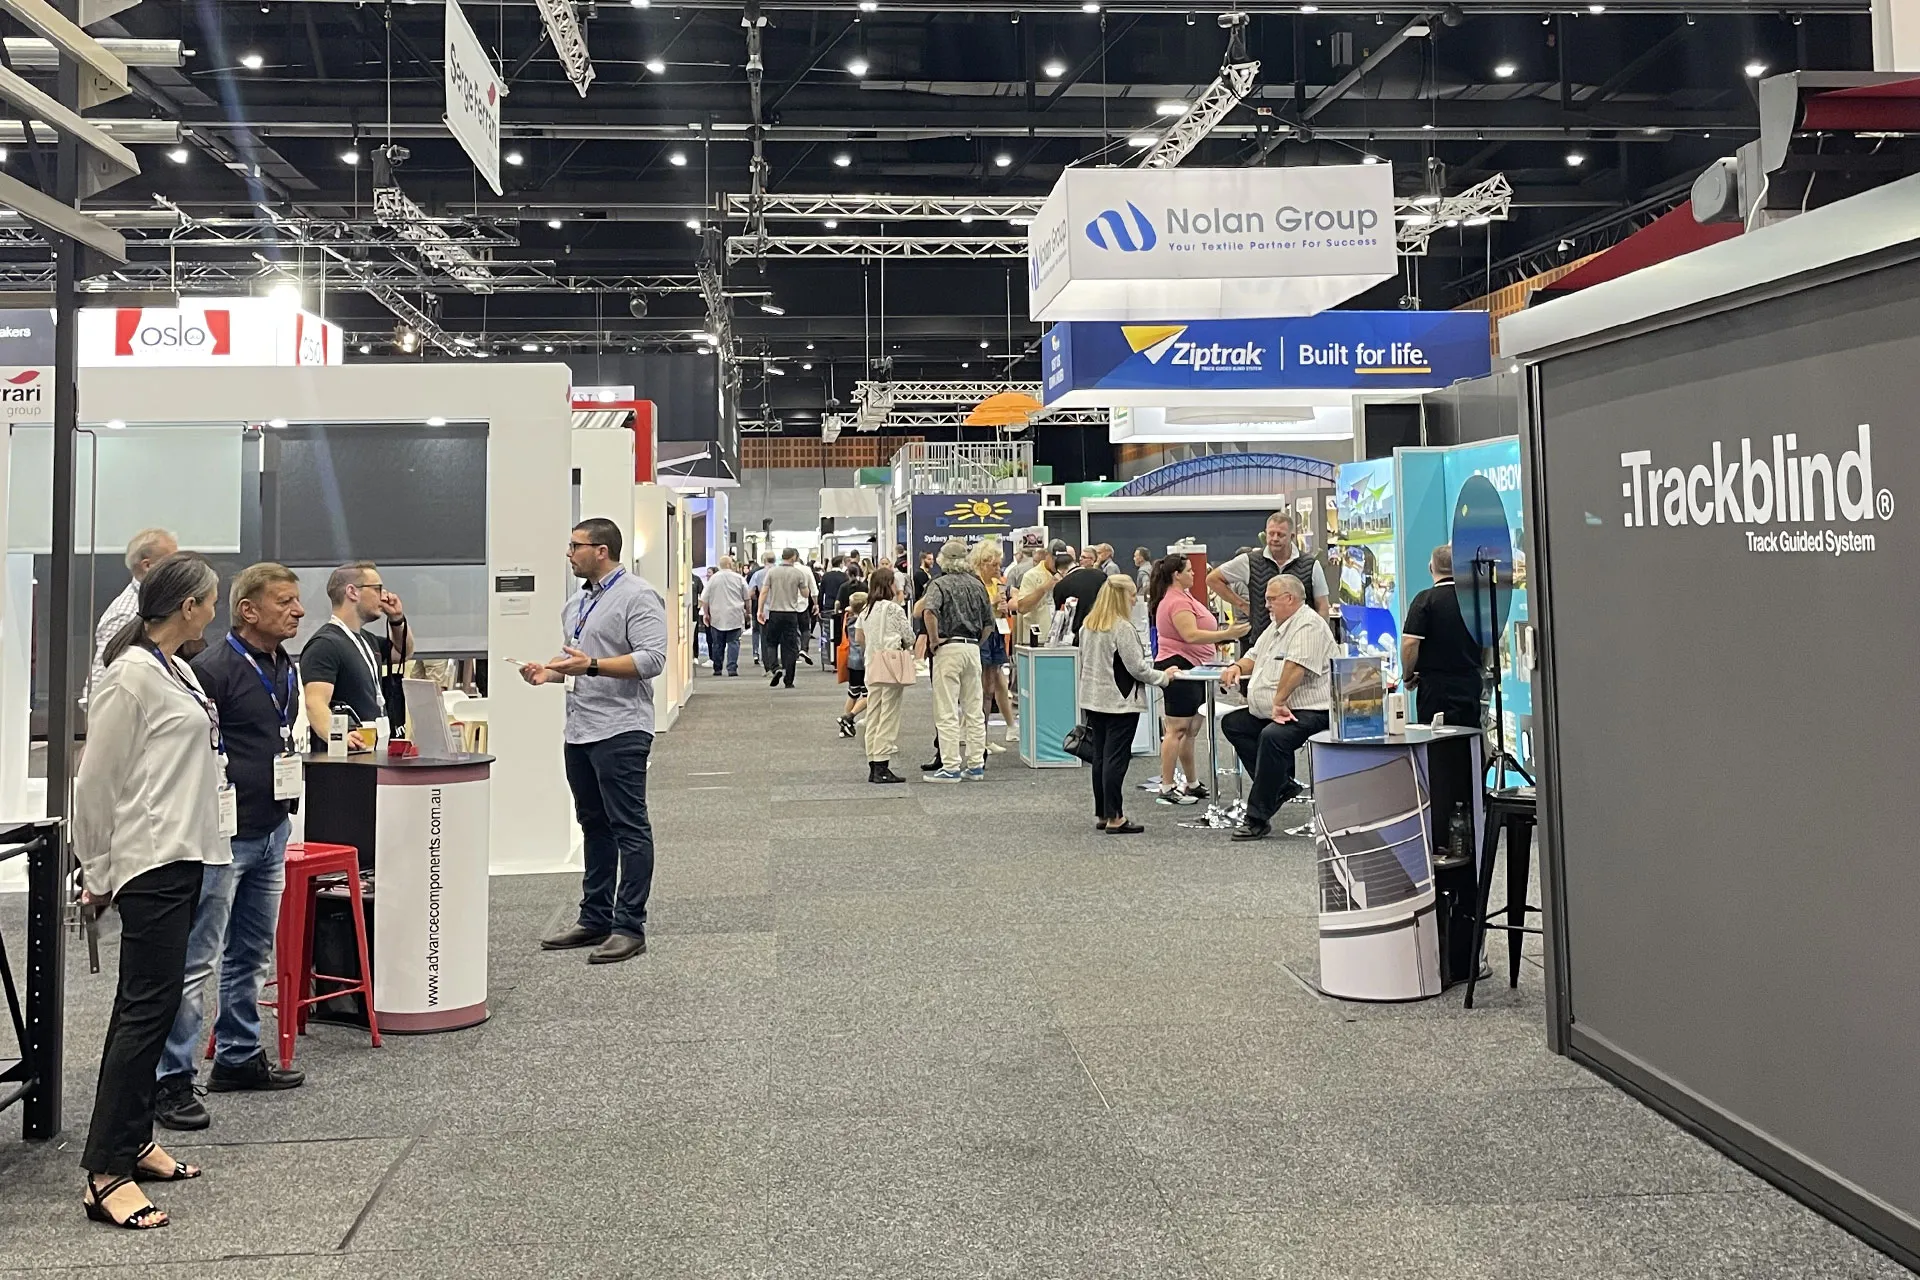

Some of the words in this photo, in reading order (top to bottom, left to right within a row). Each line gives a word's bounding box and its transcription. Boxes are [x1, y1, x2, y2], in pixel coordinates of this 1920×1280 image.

[1167, 208, 1264, 234] Nolan
[1275, 206, 1378, 235] Group
[1169, 242, 1196, 251] Your
[1203, 241, 1244, 251] Textile
[1250, 240, 1296, 250] Partner
[1303, 239, 1321, 248] For
[1326, 238, 1378, 247] Success
[140, 315, 205, 346] oslo
[1299, 343, 1349, 365] Built
[1355, 343, 1386, 365] for
[1391, 342, 1429, 365] life.
[0, 384, 41, 401] rari
[7, 406, 41, 418] group
[924, 534, 947, 544] Sydney
[1746, 531, 1779, 552] Track
[1780, 530, 1824, 552] Guided
[1825, 530, 1876, 556] System
[426, 788, 443, 1007] www.advancecomponents.com.au
